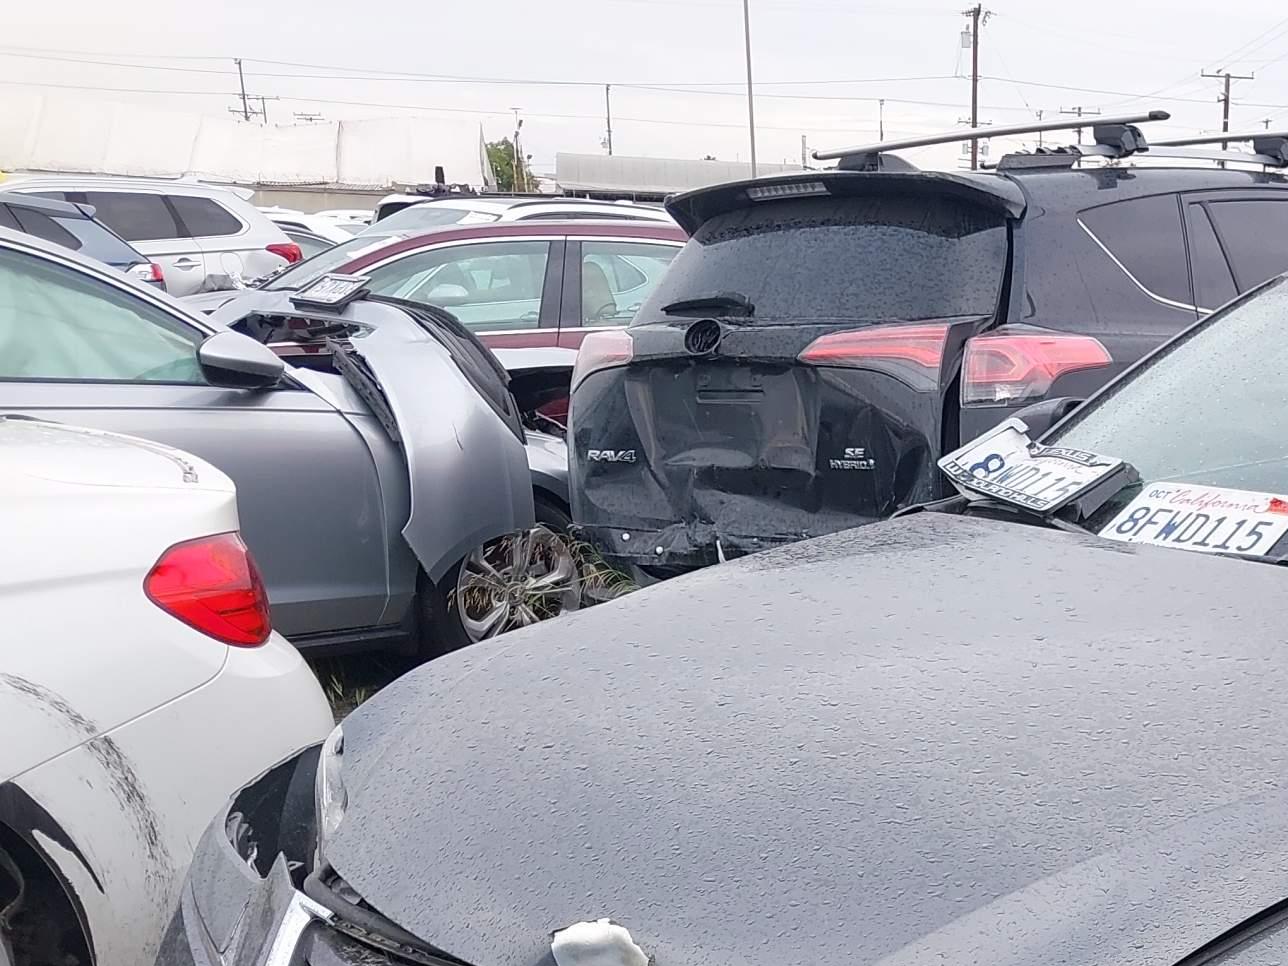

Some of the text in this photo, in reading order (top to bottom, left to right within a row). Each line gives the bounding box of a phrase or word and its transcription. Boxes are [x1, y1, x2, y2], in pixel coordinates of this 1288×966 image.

[587, 449, 637, 463] RAV4
[844, 448, 865, 458] SE
[830, 459, 868, 469] HYBRID
[1149, 489, 1172, 499] OCT
[1116, 506, 1274, 552] 8FWD115
